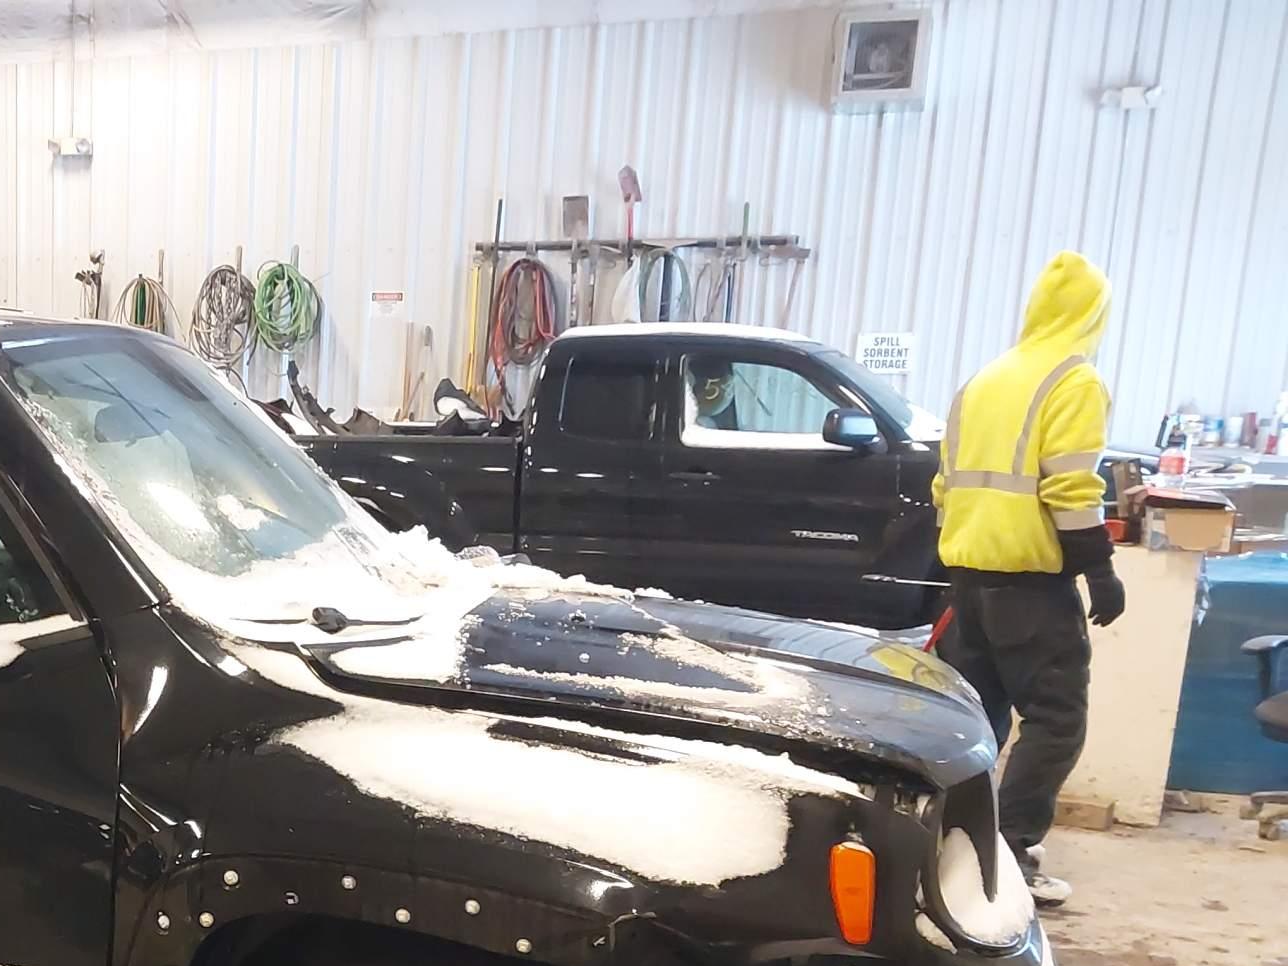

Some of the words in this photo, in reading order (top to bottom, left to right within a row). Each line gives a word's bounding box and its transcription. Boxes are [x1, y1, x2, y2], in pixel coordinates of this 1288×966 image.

[873, 336, 900, 347] SPILL
[863, 347, 909, 358] SORBENT
[863, 359, 908, 369] STORAGE
[790, 530, 859, 542] TACOMA
